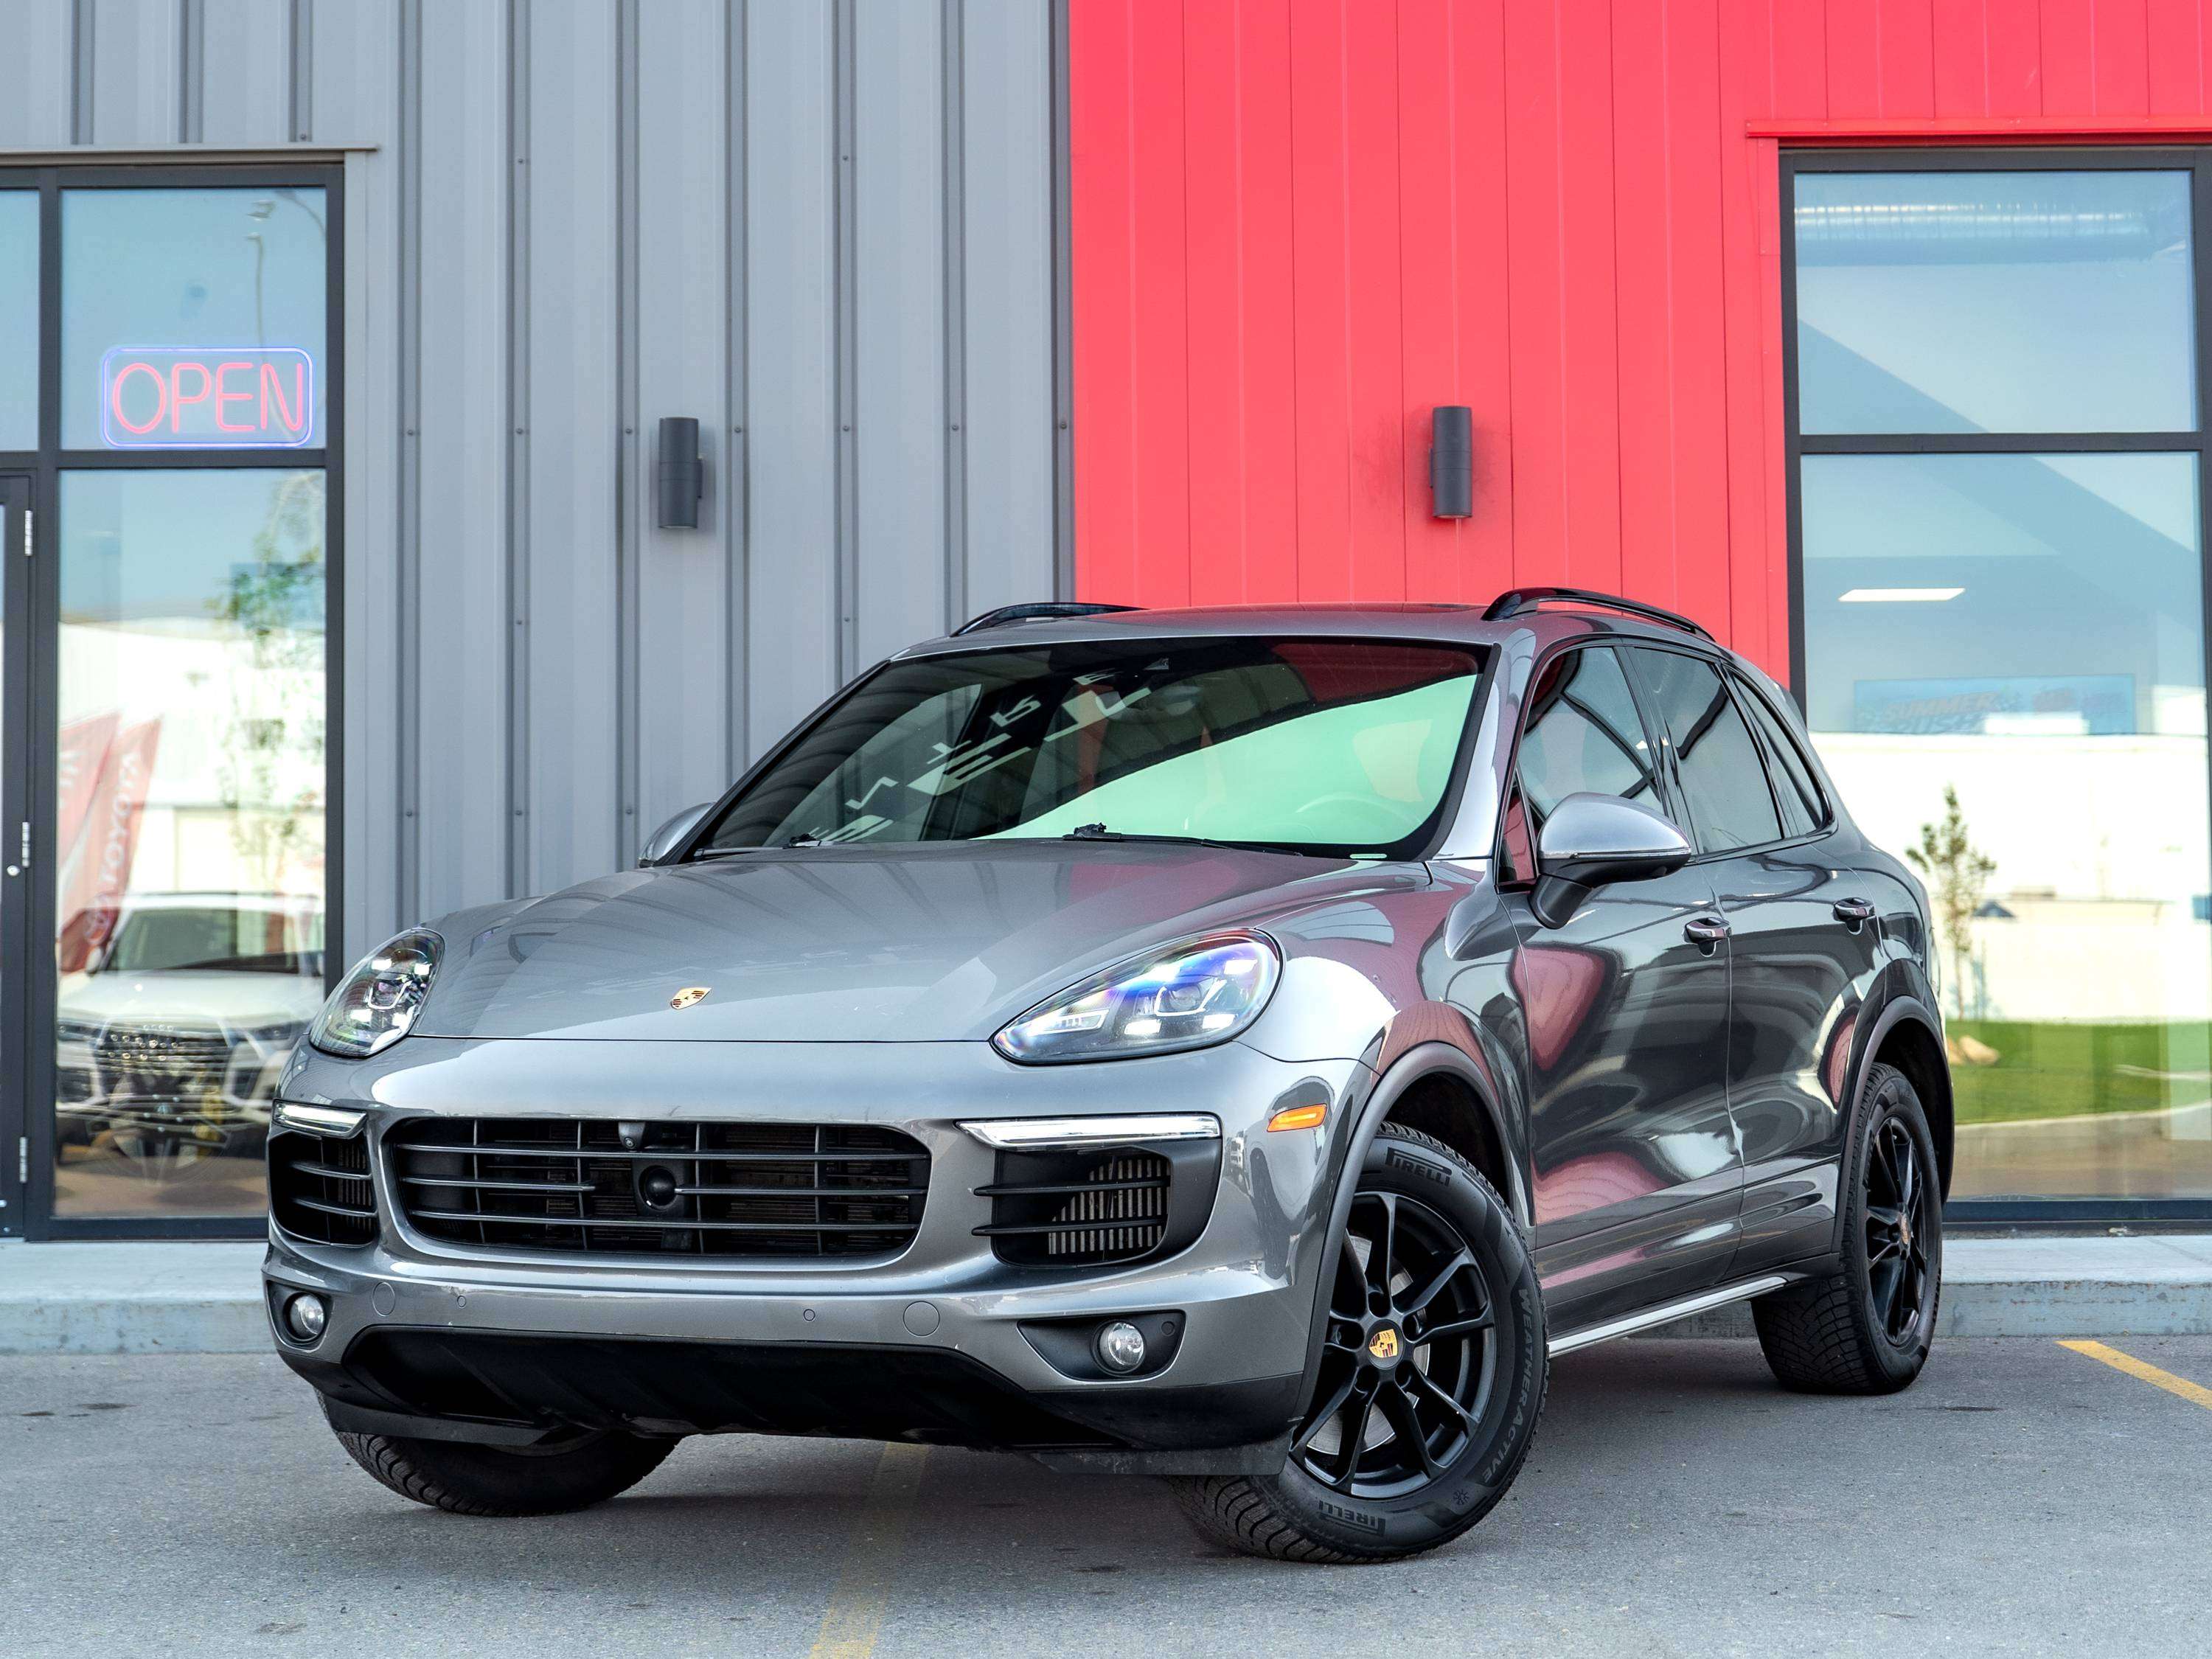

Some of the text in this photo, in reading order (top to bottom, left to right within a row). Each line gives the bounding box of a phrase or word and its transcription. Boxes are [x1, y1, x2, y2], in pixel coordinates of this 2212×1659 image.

[112, 362, 303, 434] OPEN
[98, 750, 139, 883] TOYOTA
[1385, 1147, 1452, 1186] PIRELLI
[1318, 1500, 1385, 1537] PIRELLI
